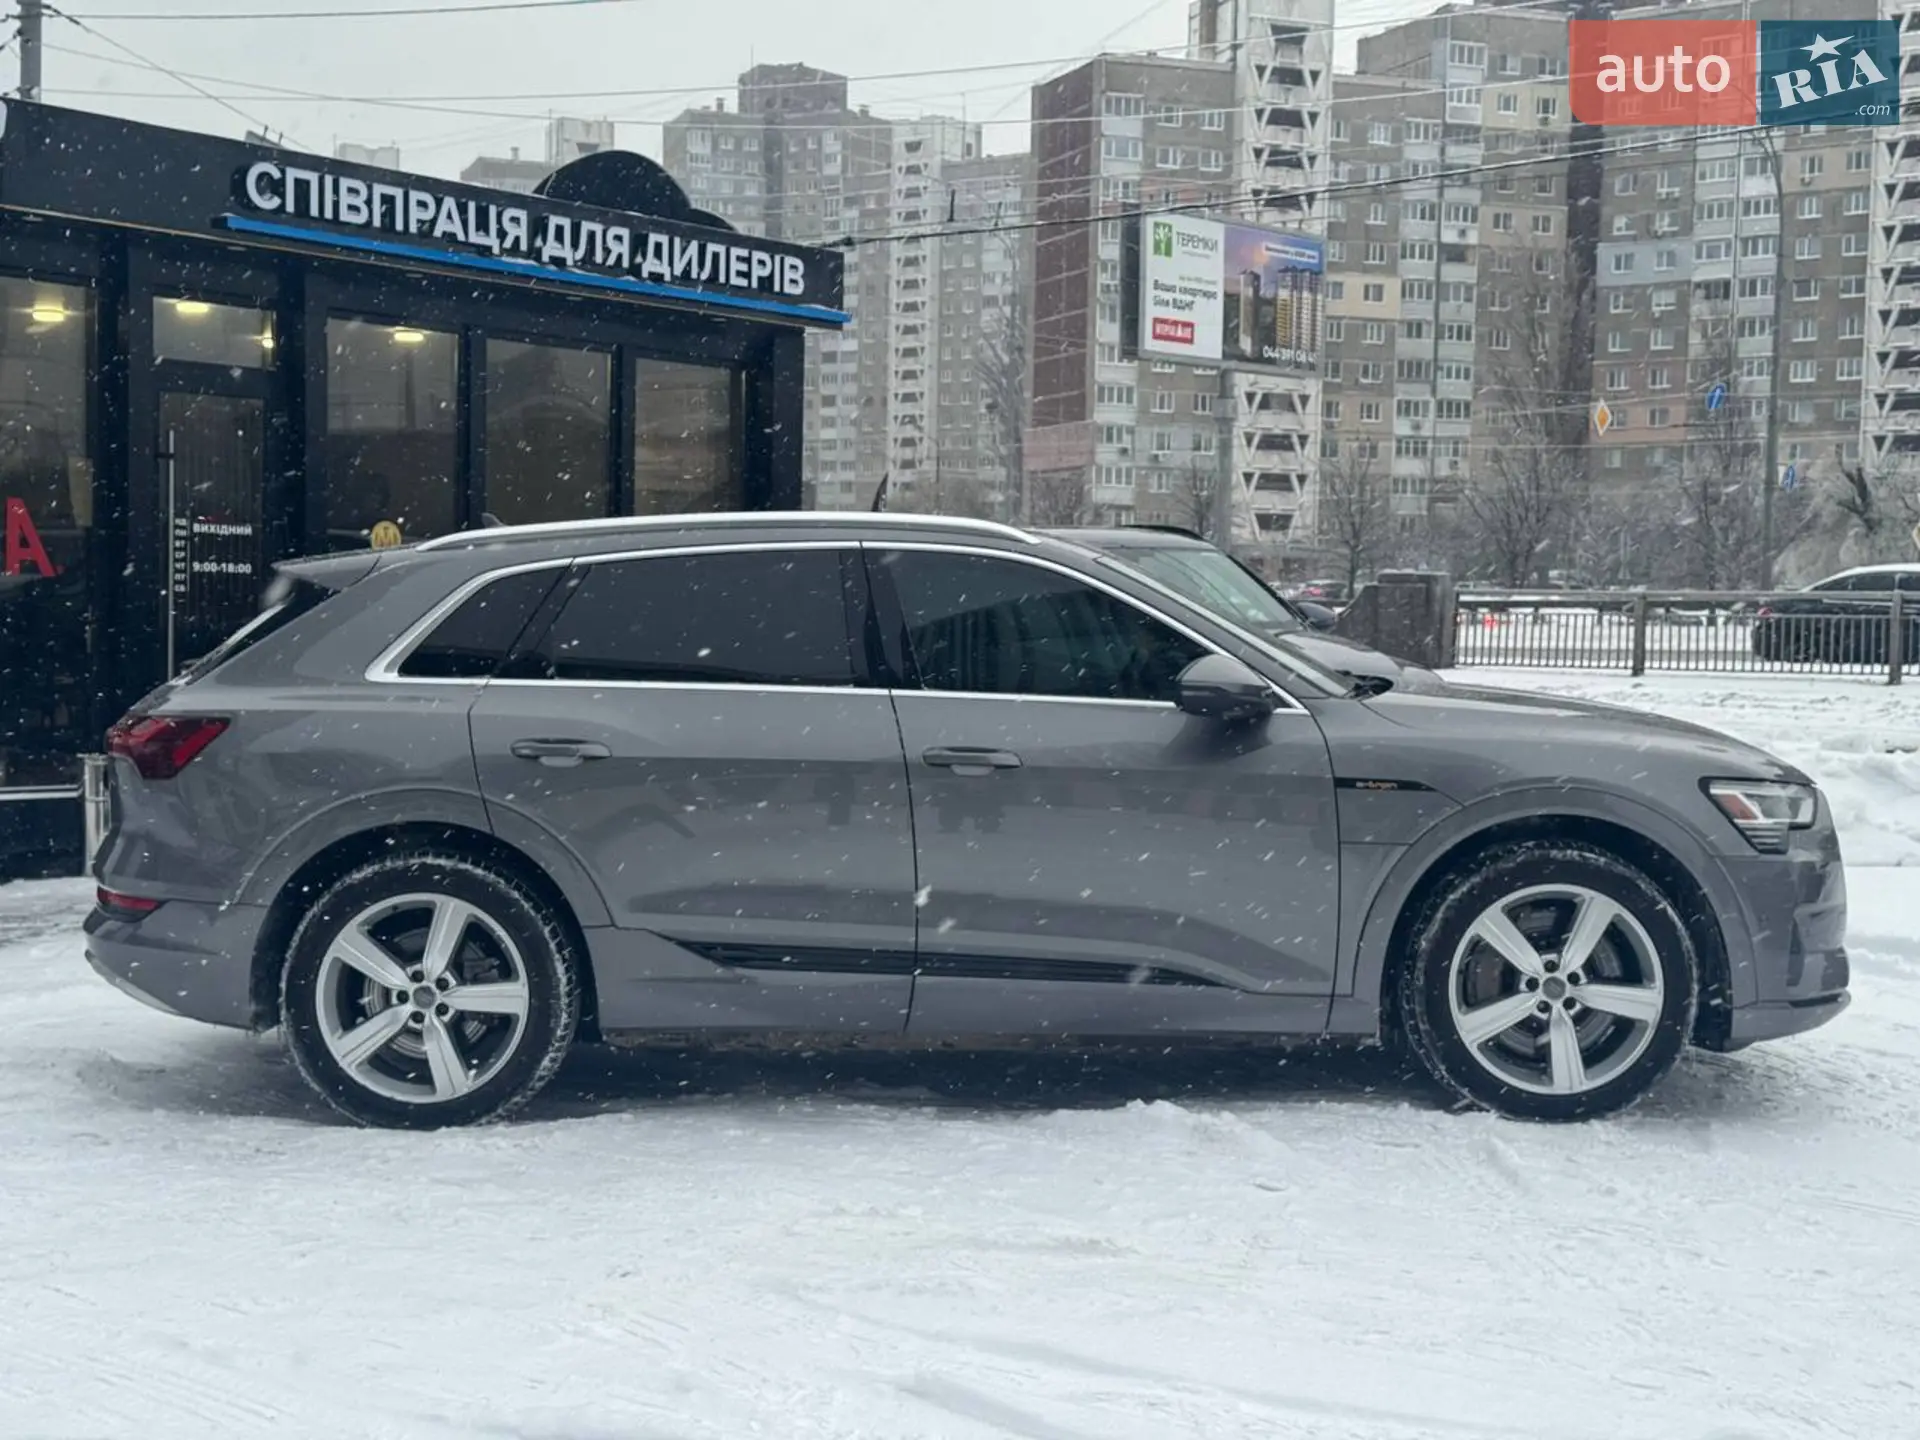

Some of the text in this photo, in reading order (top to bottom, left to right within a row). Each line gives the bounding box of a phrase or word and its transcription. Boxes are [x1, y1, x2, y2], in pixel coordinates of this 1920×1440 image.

[246, 162, 805, 296] СПІВПРАЦЯ ДЛЯ ДИЛЕРІВ
